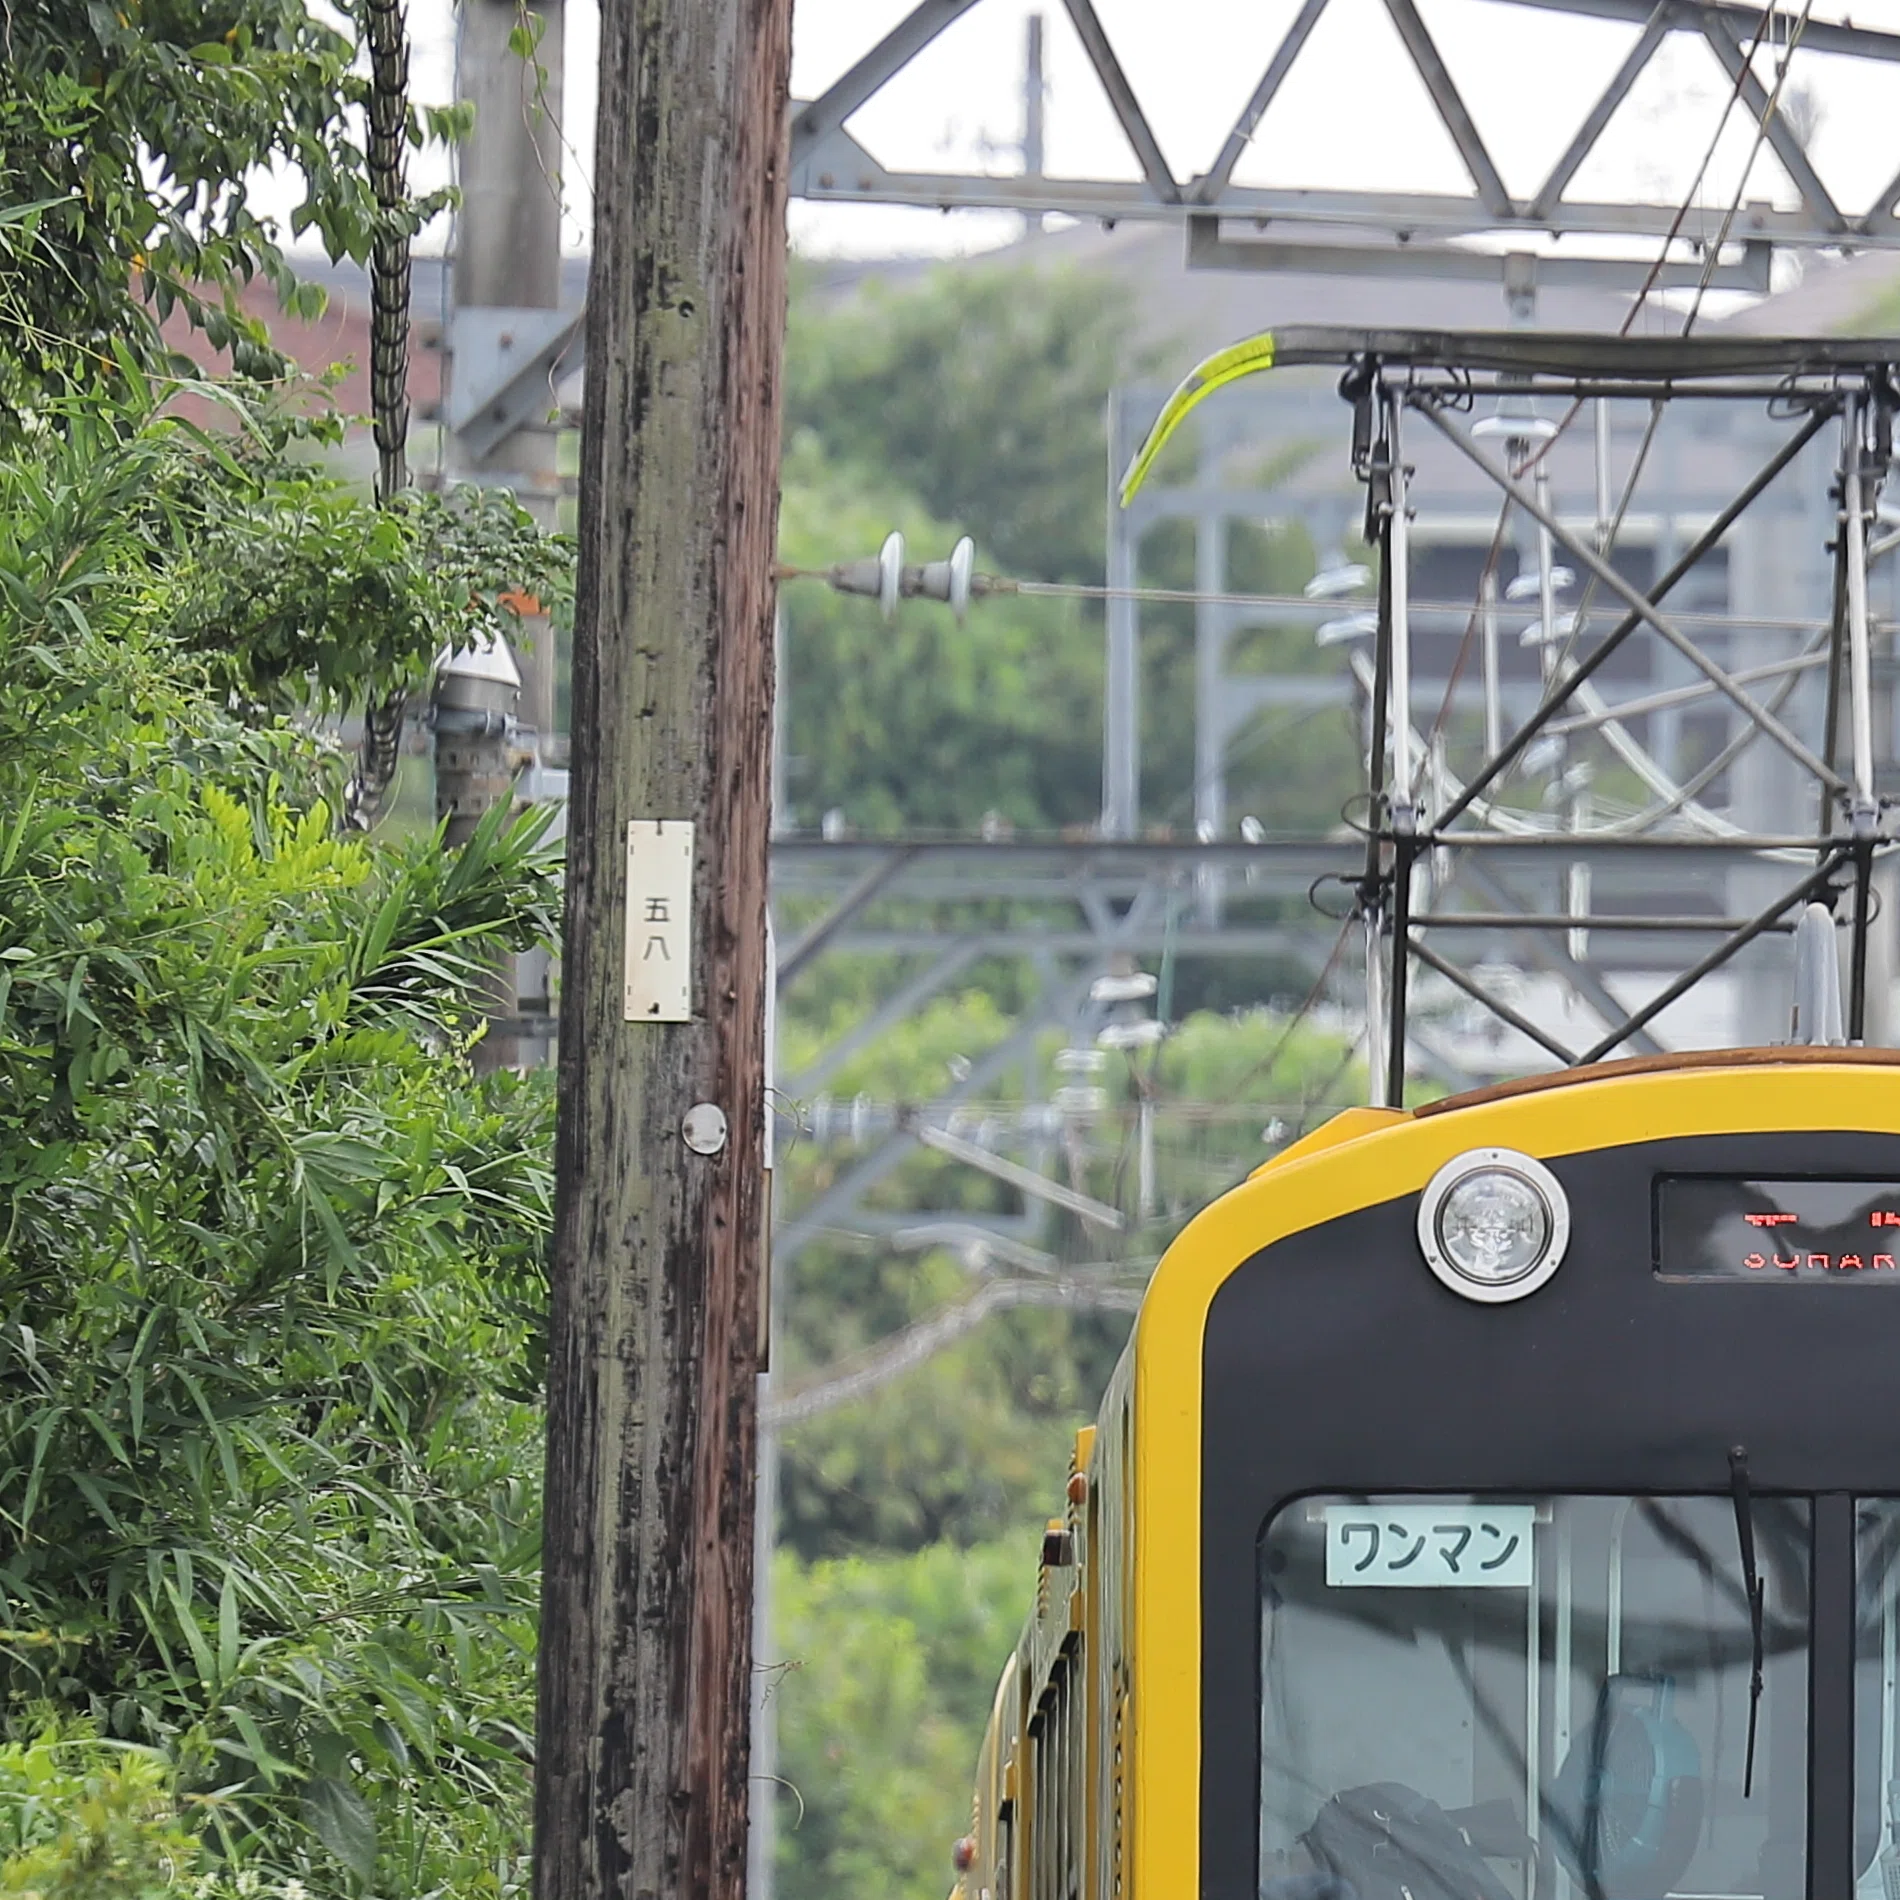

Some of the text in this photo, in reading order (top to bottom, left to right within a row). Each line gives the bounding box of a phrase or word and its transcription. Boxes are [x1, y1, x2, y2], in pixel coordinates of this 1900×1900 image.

[643, 897, 671, 961] 五八
[1341, 1522, 1520, 1574] ワンマン
